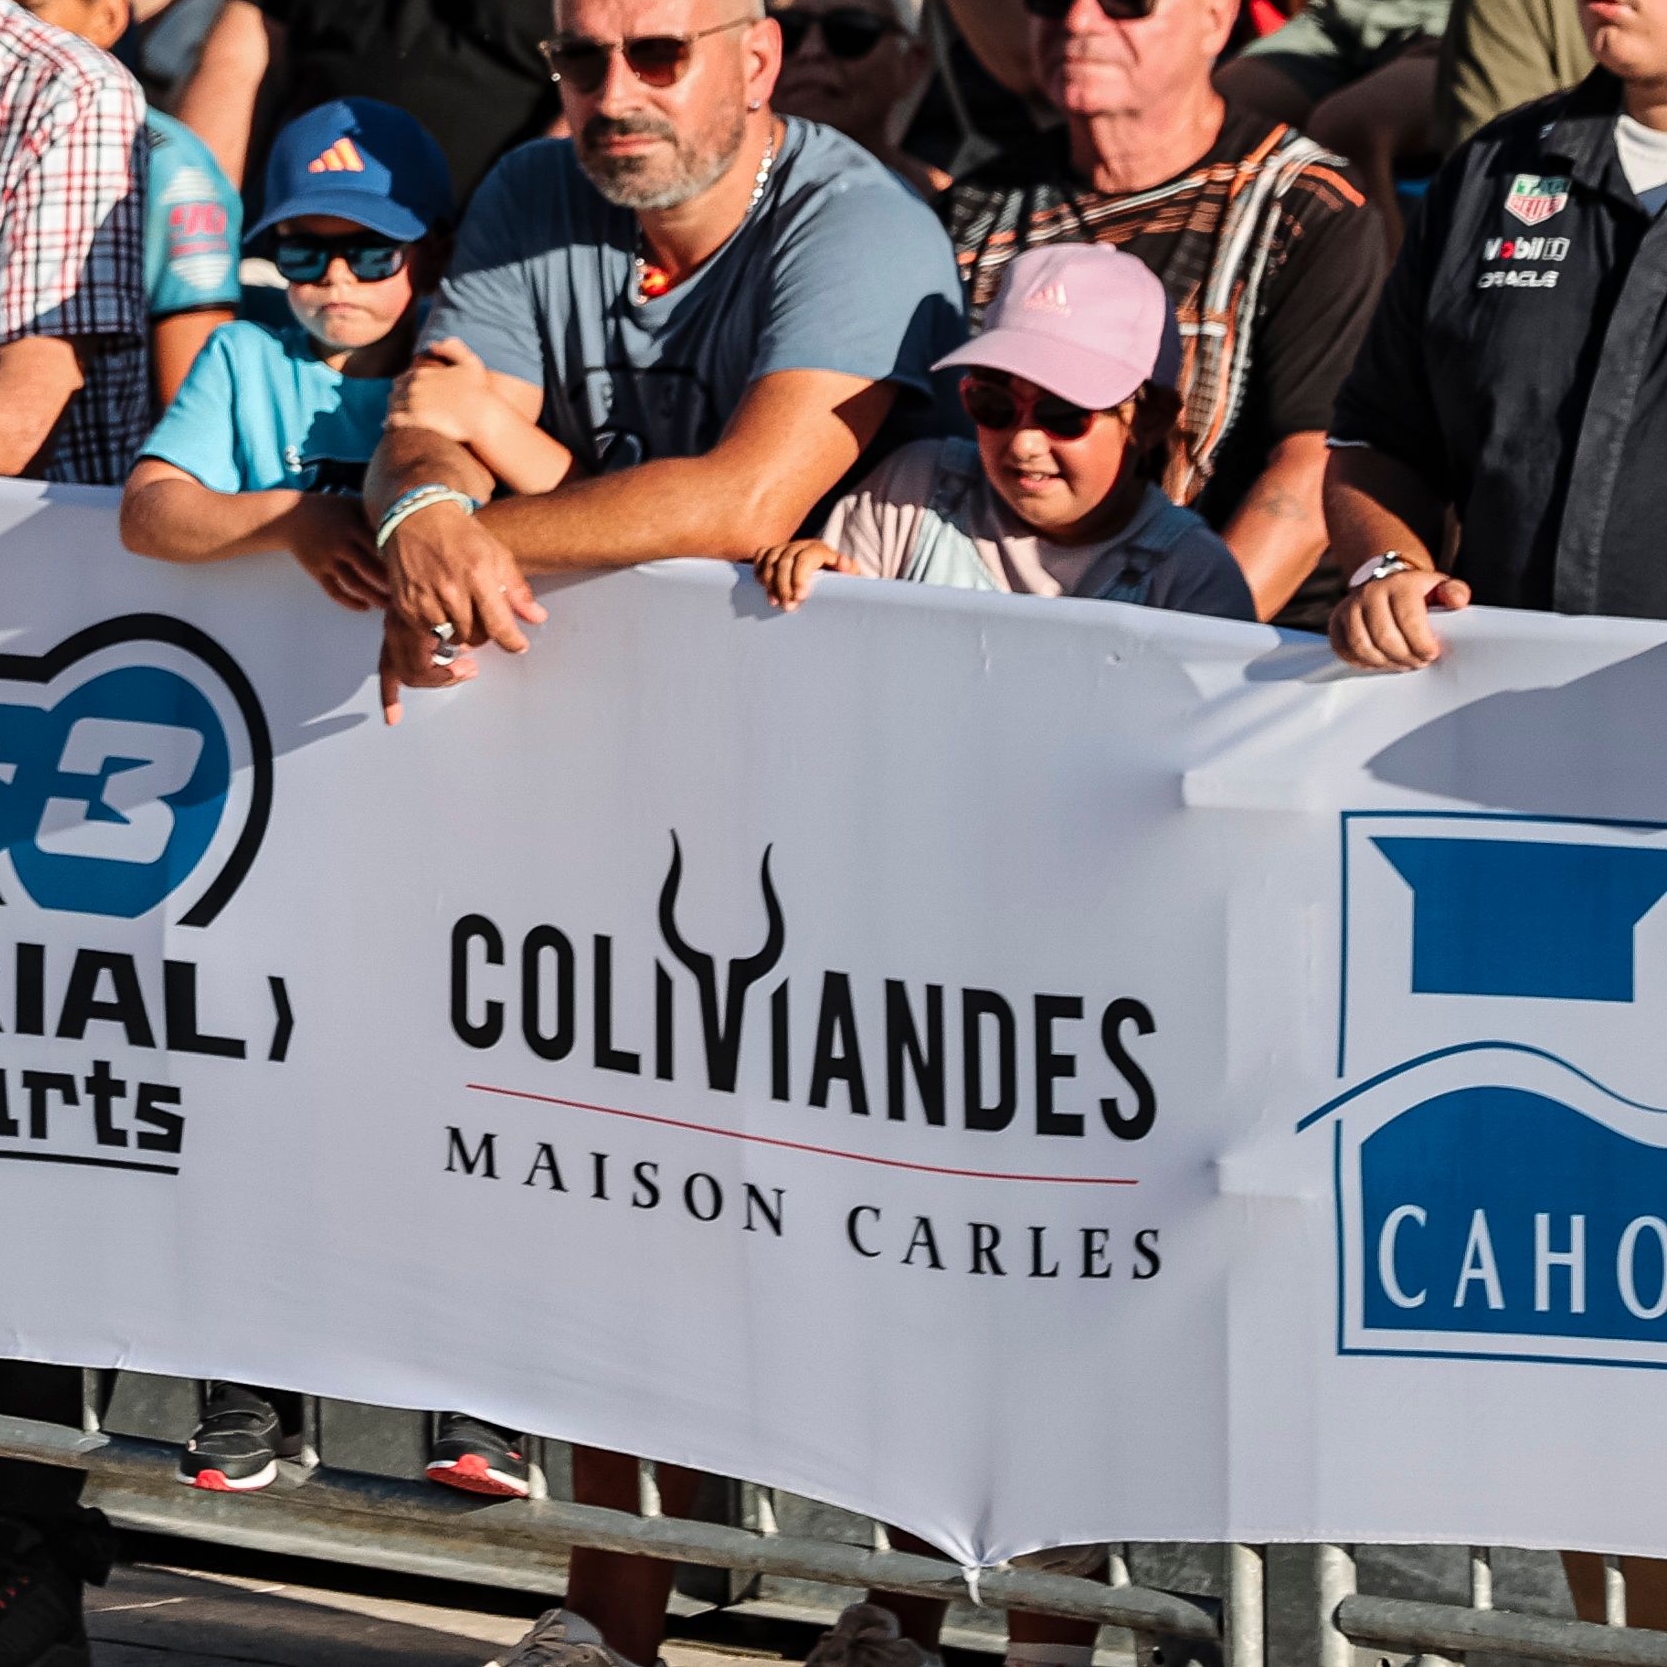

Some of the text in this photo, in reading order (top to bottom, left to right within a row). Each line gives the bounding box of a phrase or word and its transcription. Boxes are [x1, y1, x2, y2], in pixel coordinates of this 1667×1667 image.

[450, 829, 1157, 1142] COLIVIANDES
[445, 1125, 1164, 1284] MAISON CARLES
